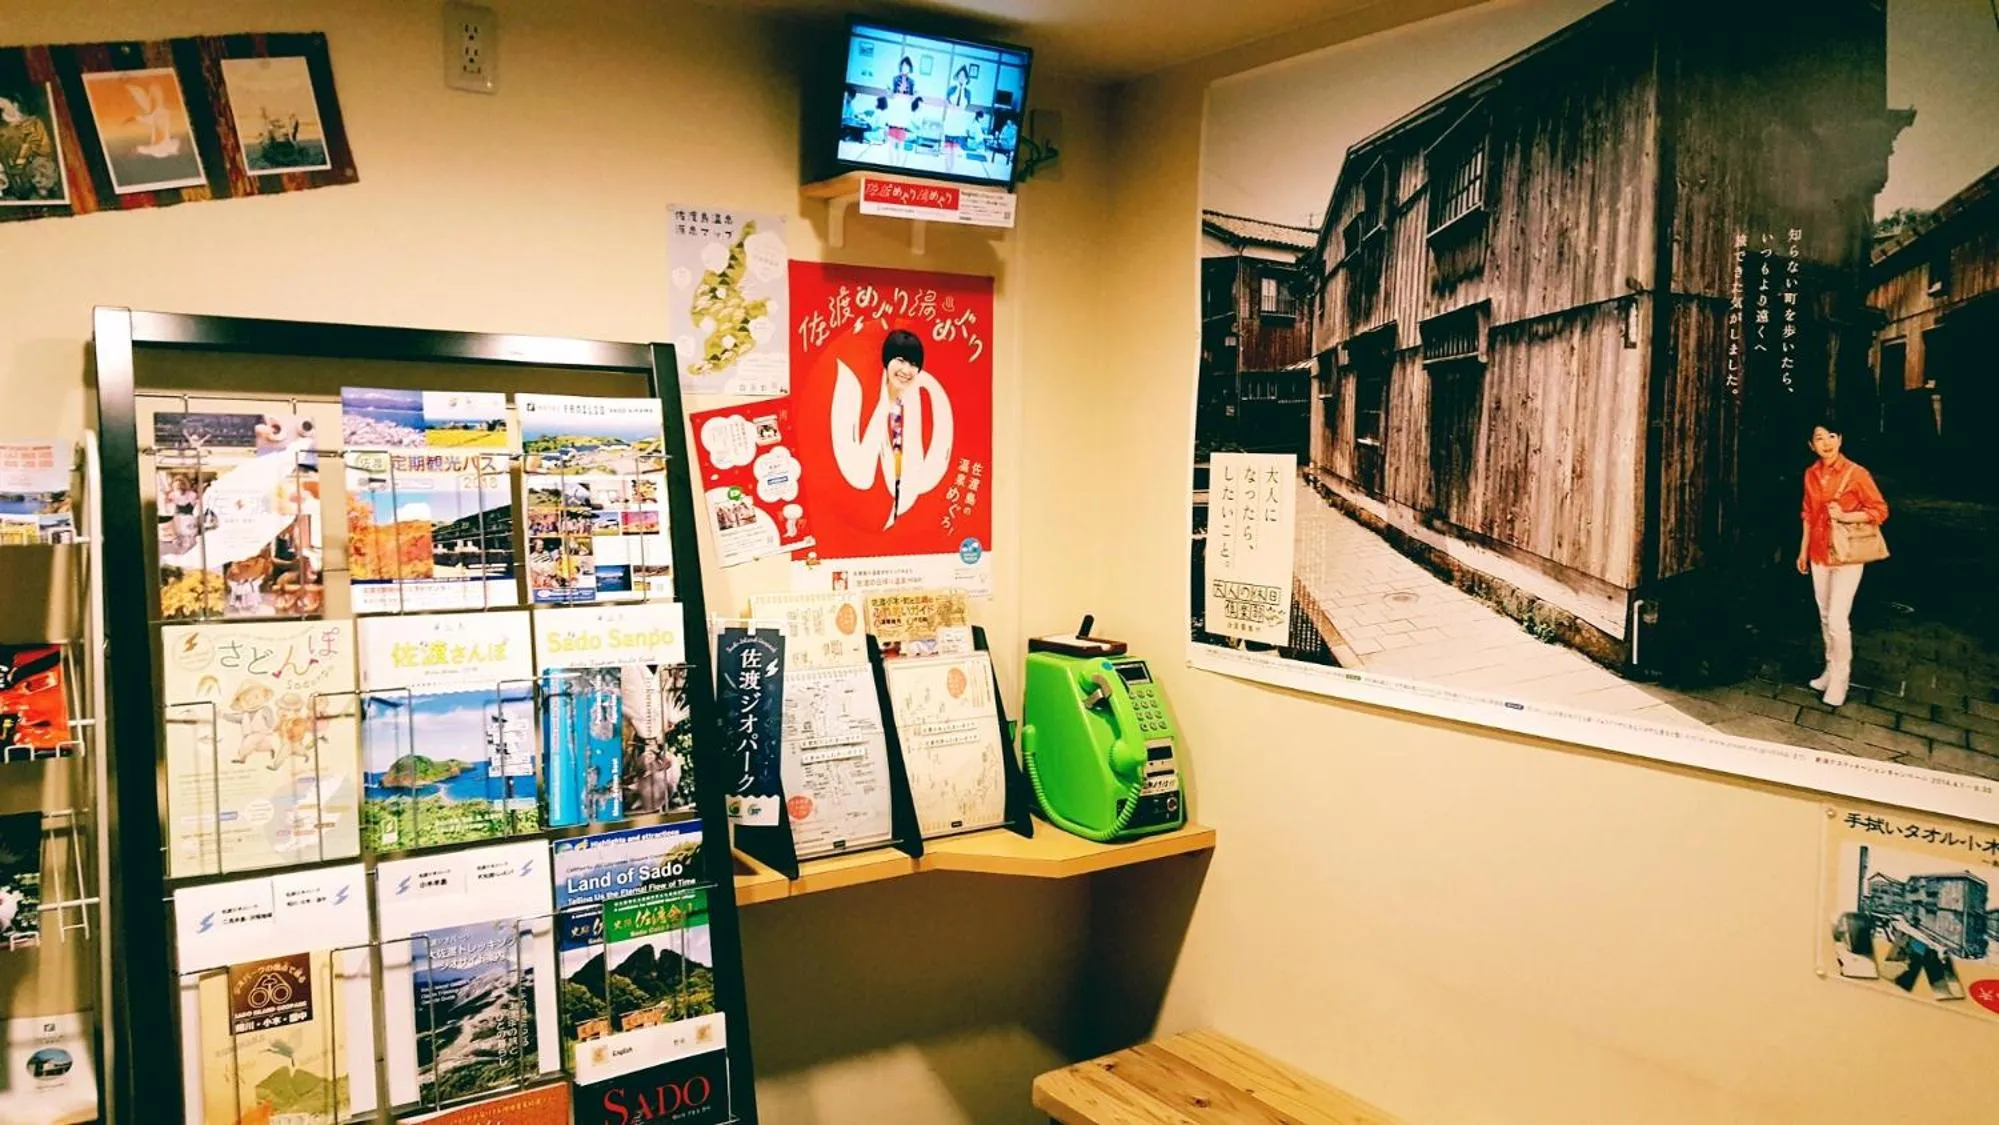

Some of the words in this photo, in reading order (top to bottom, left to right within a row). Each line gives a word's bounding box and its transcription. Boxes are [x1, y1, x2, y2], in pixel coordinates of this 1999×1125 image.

[1727, 234, 1747, 394] 旅できた気がしました。
[1754, 233, 1774, 352] いつもより遠くへ
[1781, 228, 1802, 393] 知らない町を歩いたら、
[392, 455, 496, 472] 定期観光バス
[831, 358, 954, 531] ゆ
[963, 462, 983, 516] 佐渡島の
[1242, 466, 1256, 550] なったら、
[1265, 466, 1278, 522] 大人に
[391, 640, 507, 668] 佐渡さんぽ
[547, 630, 601, 652] Sado
[608, 627, 674, 651] Sanpo
[737, 648, 762, 792] 佐渡ジオパーク
[567, 870, 611, 894] Land
[616, 869, 634, 885] of
[639, 861, 683, 880] Sado
[595, 892, 606, 902] Us
[606, 889, 619, 899] the
[620, 886, 647, 897] Eternal
[603, 1075, 711, 1125] SADO
